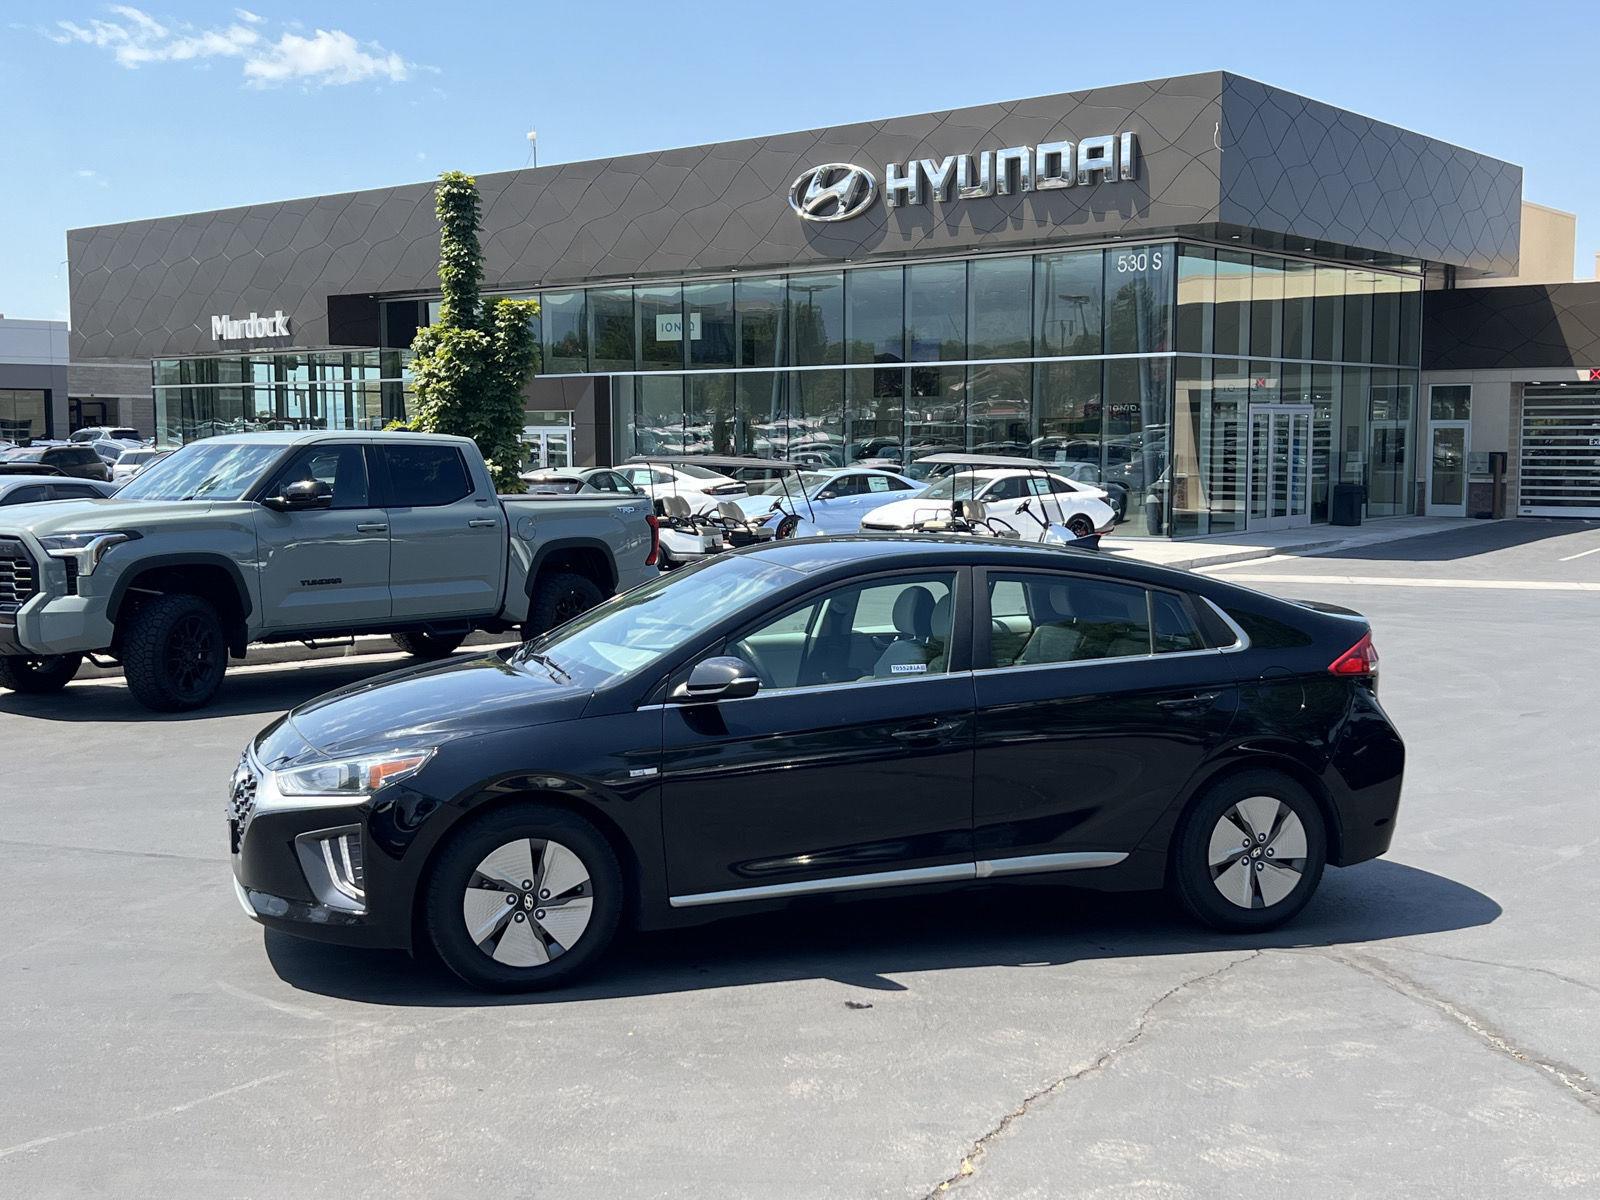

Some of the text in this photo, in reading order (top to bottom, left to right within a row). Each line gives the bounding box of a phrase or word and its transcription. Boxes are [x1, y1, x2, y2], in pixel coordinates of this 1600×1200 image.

[886, 131, 1137, 208] HYUNDAI
[1117, 252, 1162, 273] 530 S
[211, 310, 291, 341] Murdock
[616, 505, 635, 514] TRD
